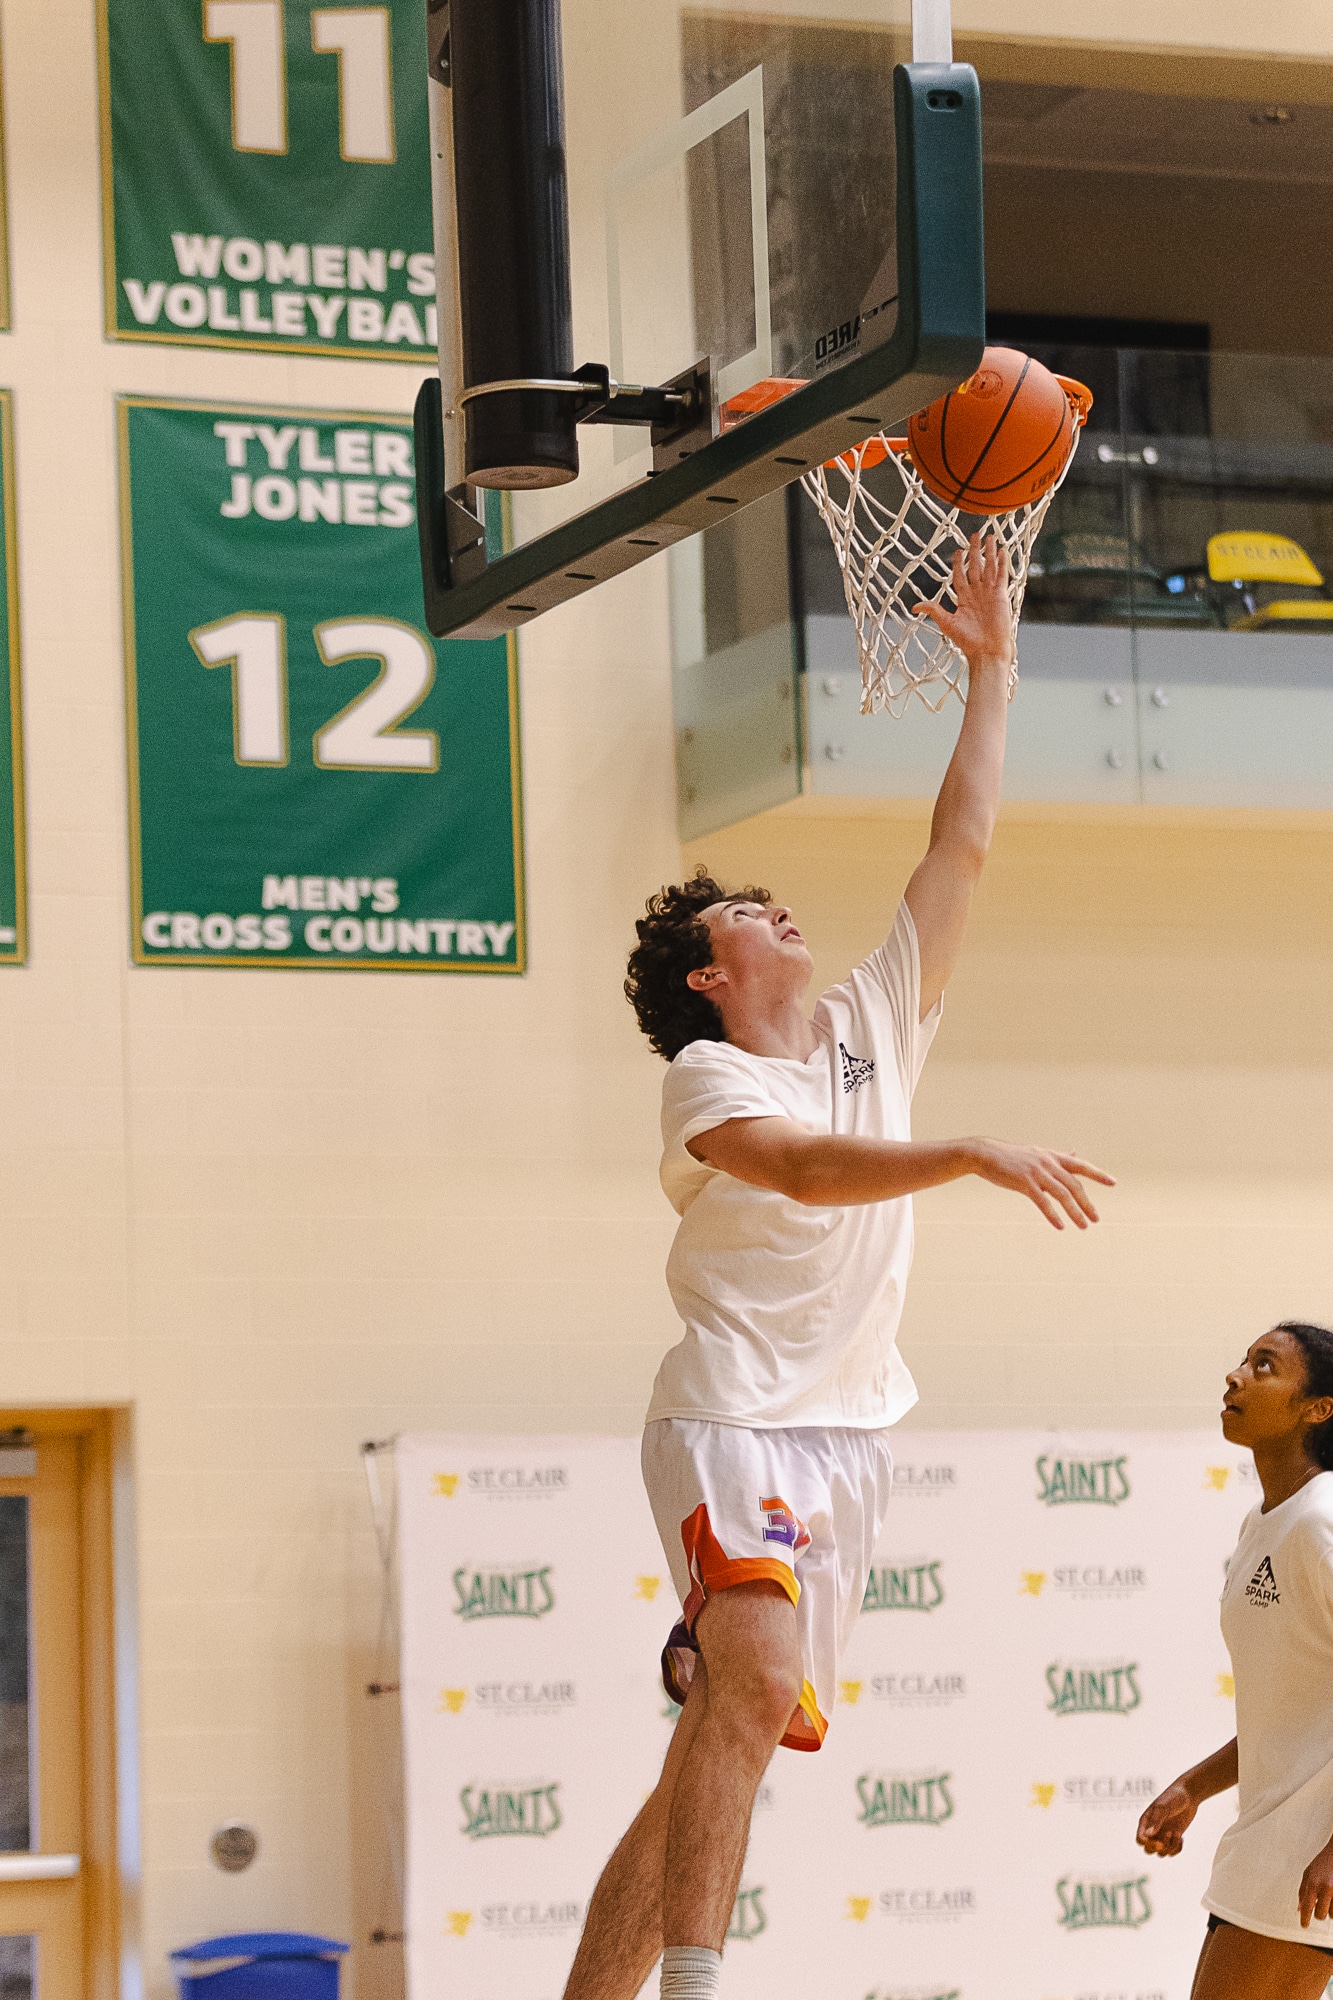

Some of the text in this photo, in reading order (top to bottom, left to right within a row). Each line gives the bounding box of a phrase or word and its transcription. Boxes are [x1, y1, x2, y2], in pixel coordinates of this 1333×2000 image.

[202, 0, 396, 163] 11
[171, 232, 436, 296] WOMEN'S
[213, 420, 415, 477] TYLER
[220, 473, 415, 528] JONES
[188, 610, 440, 773] 12
[261, 875, 399, 913] MEN'S
[142, 912, 514, 956] CROSS COUNTRY
[892, 1465, 957, 1486] CLAIR
[1036, 1454, 1131, 1507] SAINTS
[451, 1565, 554, 1620] SAINTS
[860, 1560, 944, 1612] AINTS
[1245, 1585, 1281, 1604] SPARK
[1249, 1598, 1269, 1609] CAMP
[1045, 1661, 1142, 1716] SAINTS
[459, 1782, 563, 1840] SAINTS
[856, 1771, 954, 1828] SAINTS
[1056, 1874, 1152, 1931] SAINTS
